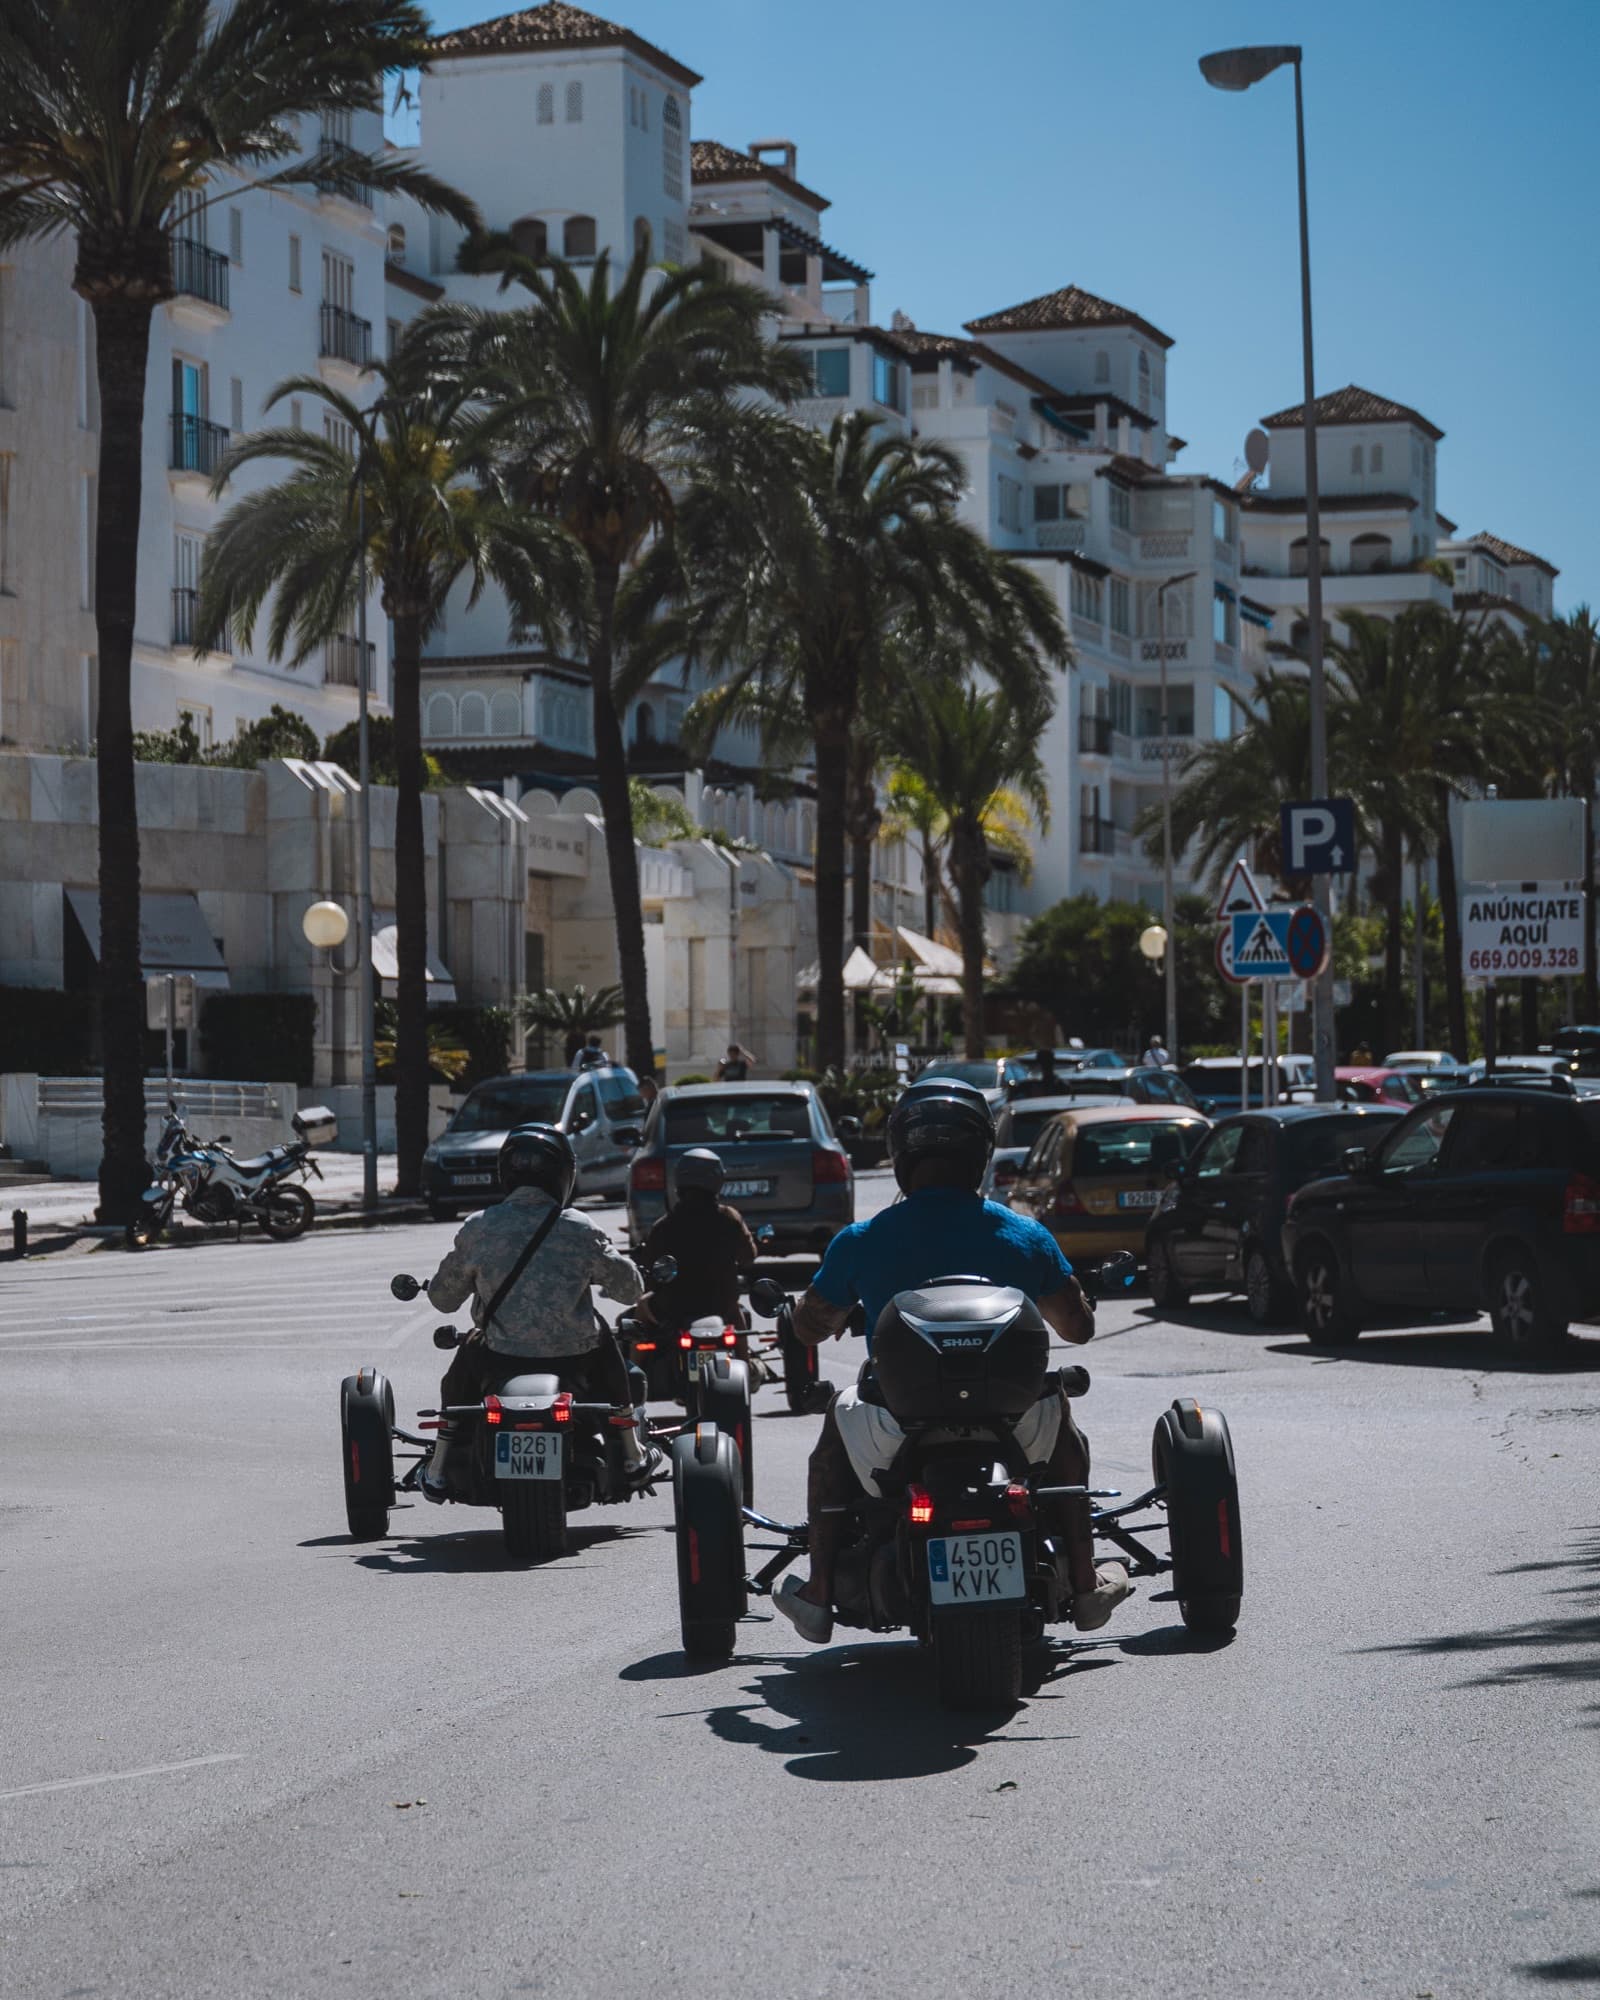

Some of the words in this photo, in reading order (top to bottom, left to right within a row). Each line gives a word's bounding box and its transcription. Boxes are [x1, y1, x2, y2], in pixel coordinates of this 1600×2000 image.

[1291, 808, 1336, 868] P
[1469, 896, 1579, 921] ANÚNCIATE
[1500, 920, 1549, 946] AQUÍ
[1469, 948, 1578, 969] 669.009.328
[942, 1338, 983, 1347] SHAD
[511, 1436, 557, 1455] 8261
[511, 1456, 546, 1475] NMW
[951, 1538, 1016, 1568] 4506
[952, 1568, 1002, 1597] KVK
